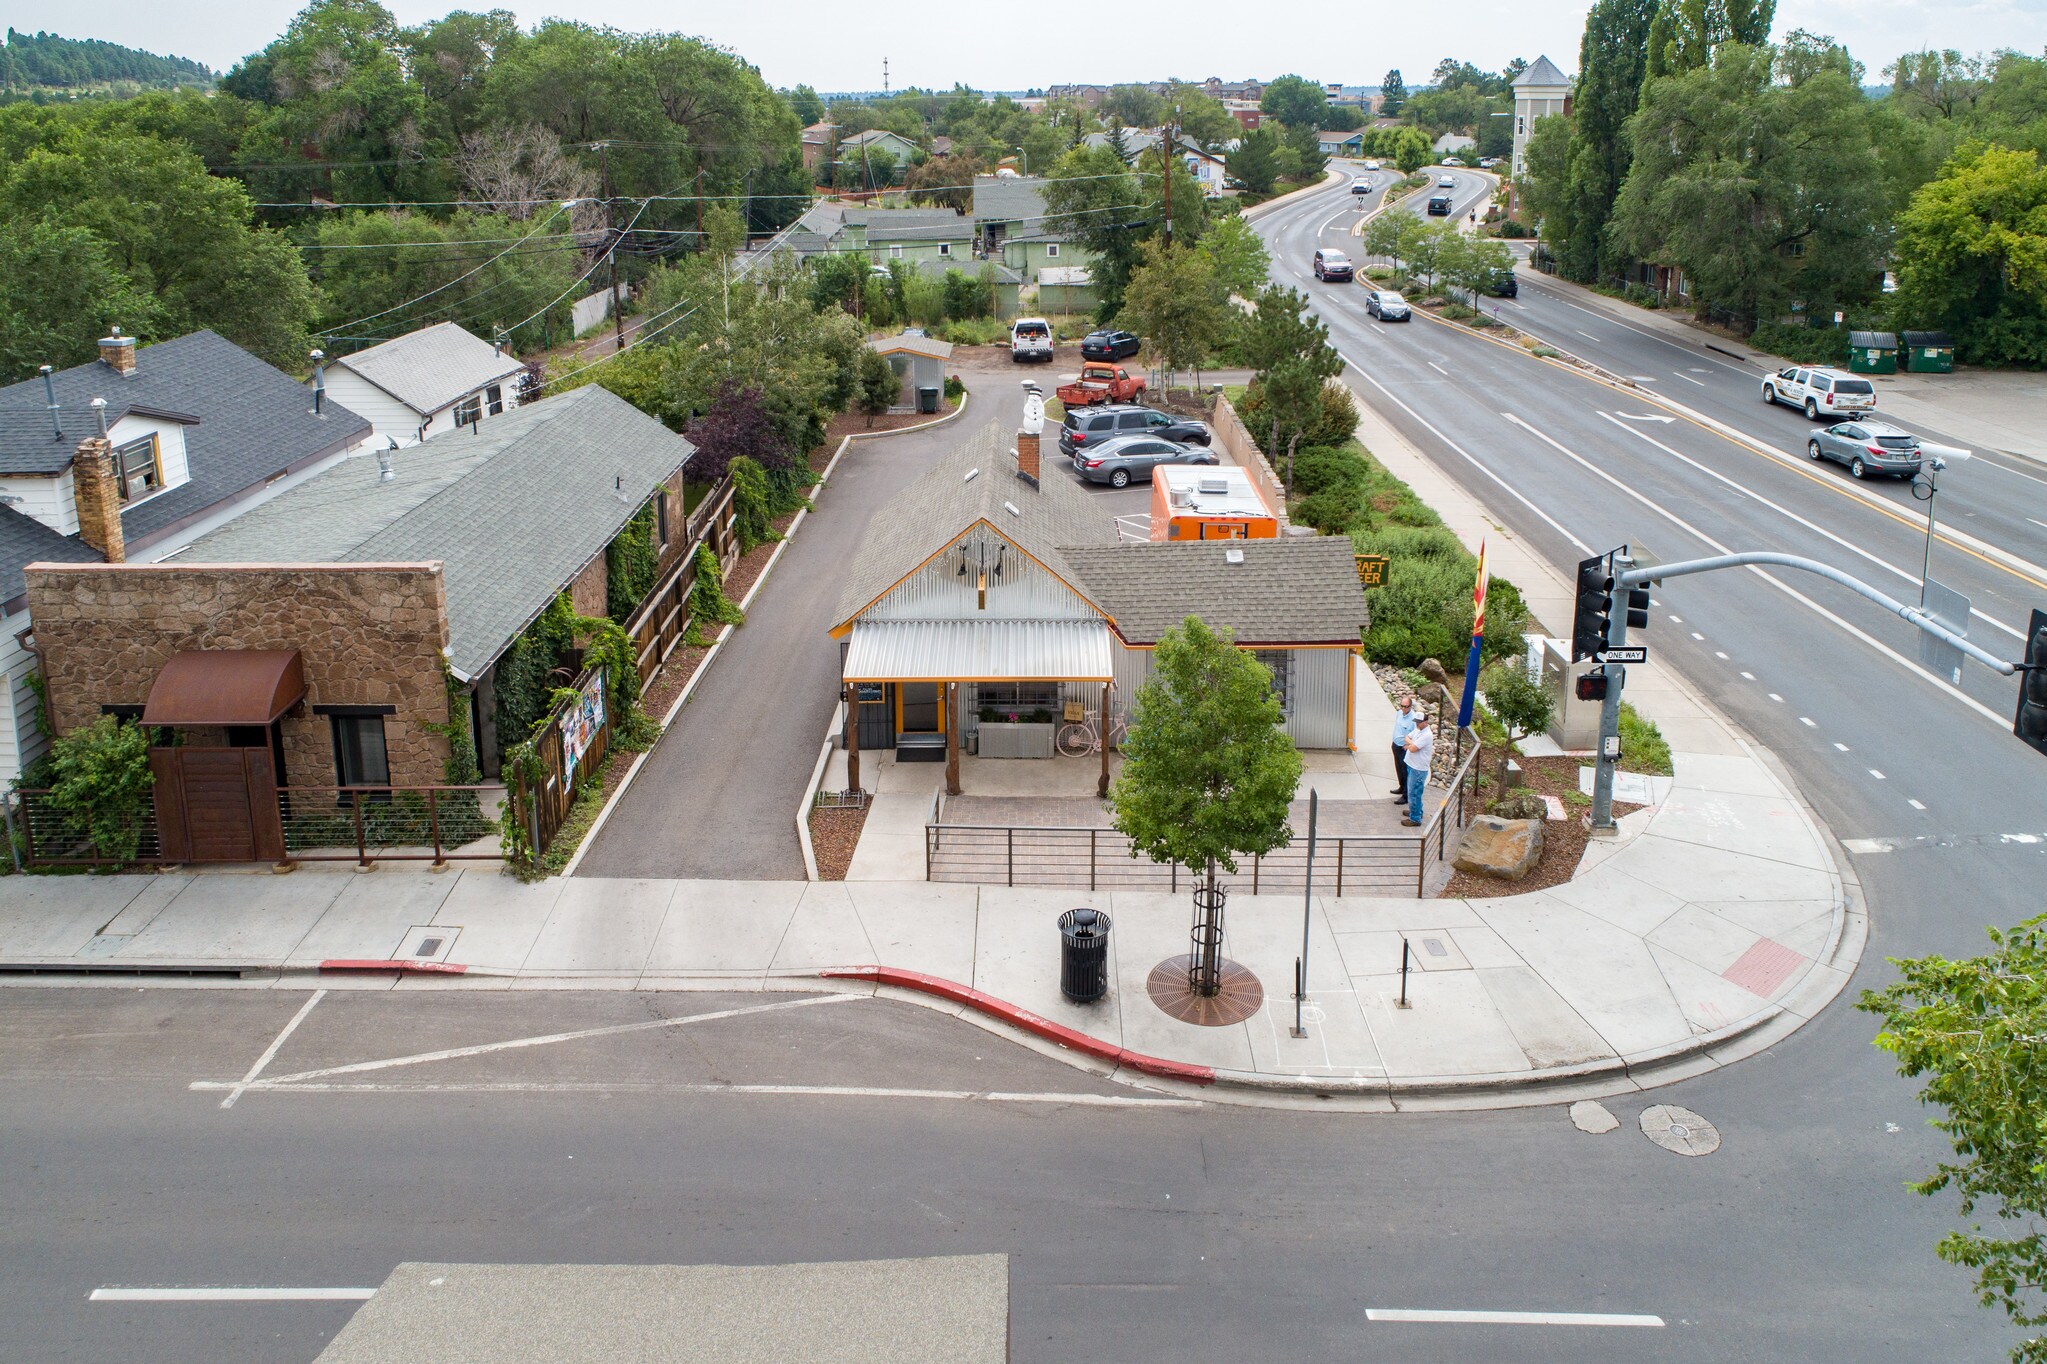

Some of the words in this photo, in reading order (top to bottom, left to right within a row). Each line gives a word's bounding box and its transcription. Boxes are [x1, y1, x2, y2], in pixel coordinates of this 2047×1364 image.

[1357, 561, 1385, 572] RAFT
[1359, 572, 1381, 584] EER
[1608, 651, 1623, 659] ONE
[1625, 651, 1641, 659] WAY
